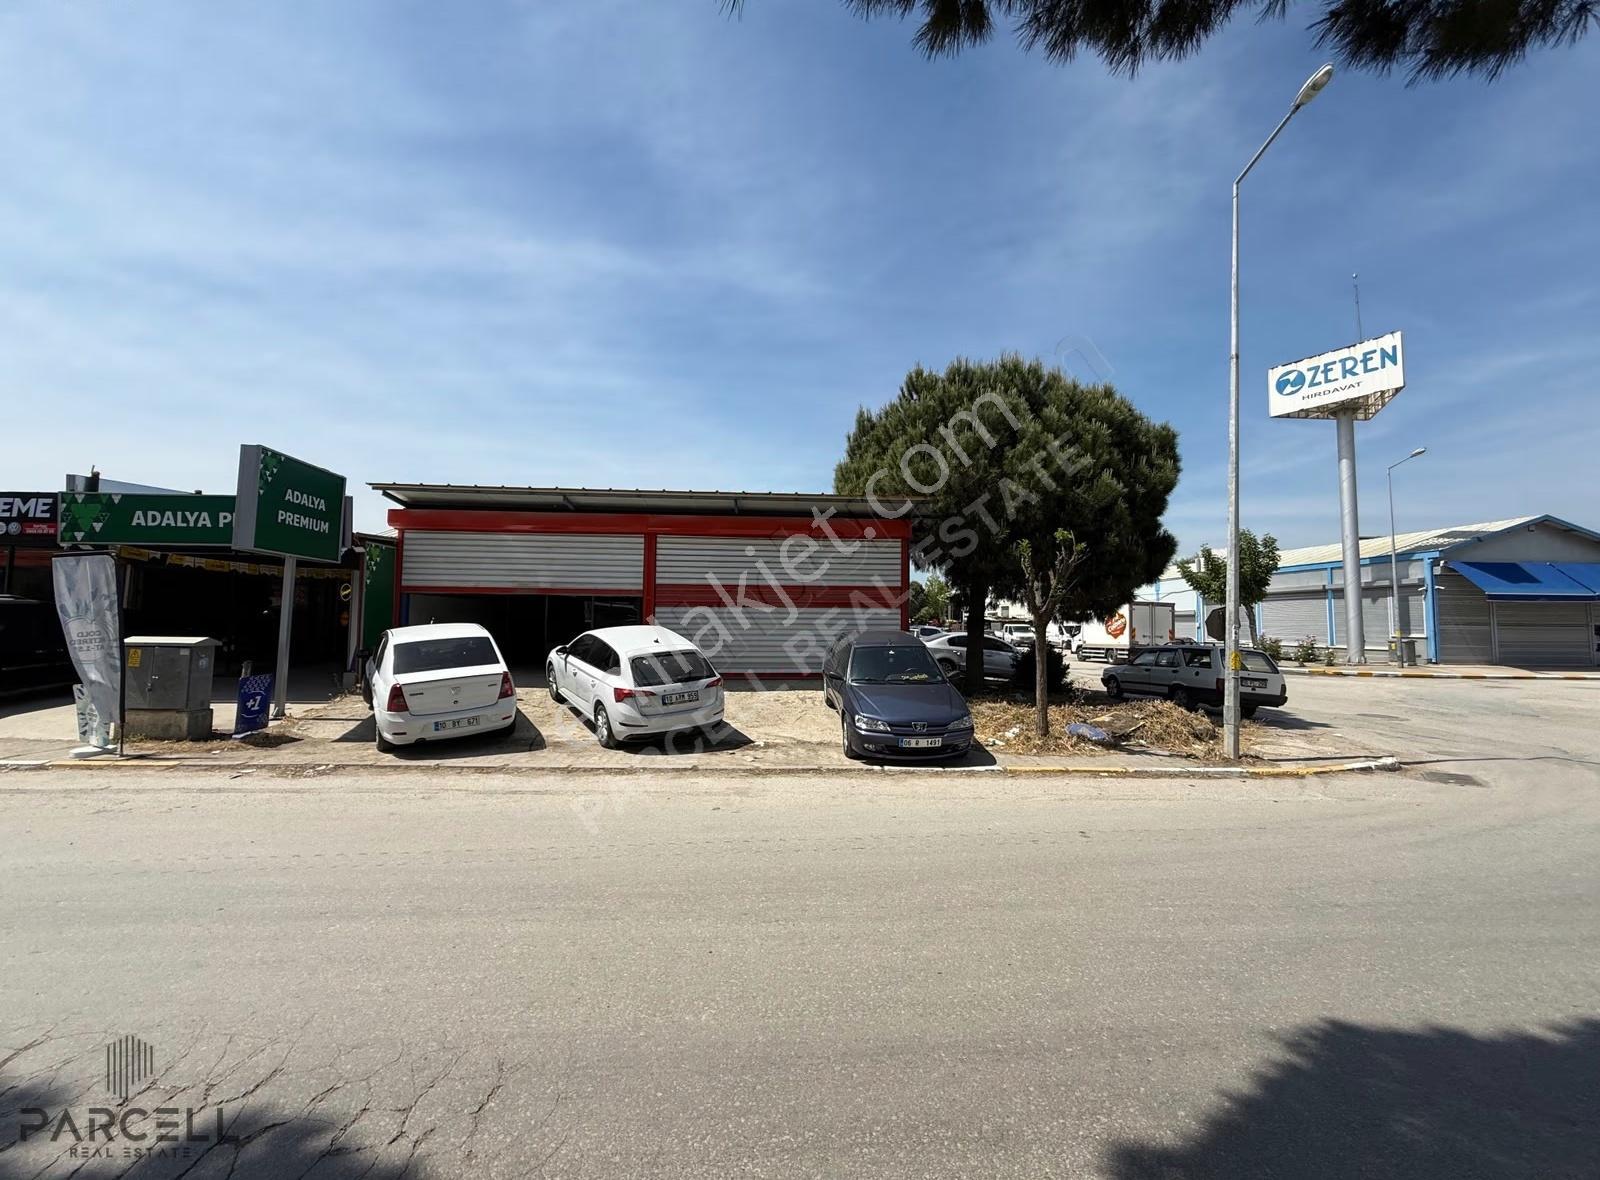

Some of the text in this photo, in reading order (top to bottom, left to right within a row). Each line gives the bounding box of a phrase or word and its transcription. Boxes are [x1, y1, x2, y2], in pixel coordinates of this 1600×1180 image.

[1302, 381, 1363, 401] HIRDAVAT
[285, 488, 327, 512] ADALYA
[131, 510, 212, 528] ADALYA
[278, 510, 329, 534] PREMIUM
[903, 739, 912, 747] 06
[926, 738, 940, 746] 1491
